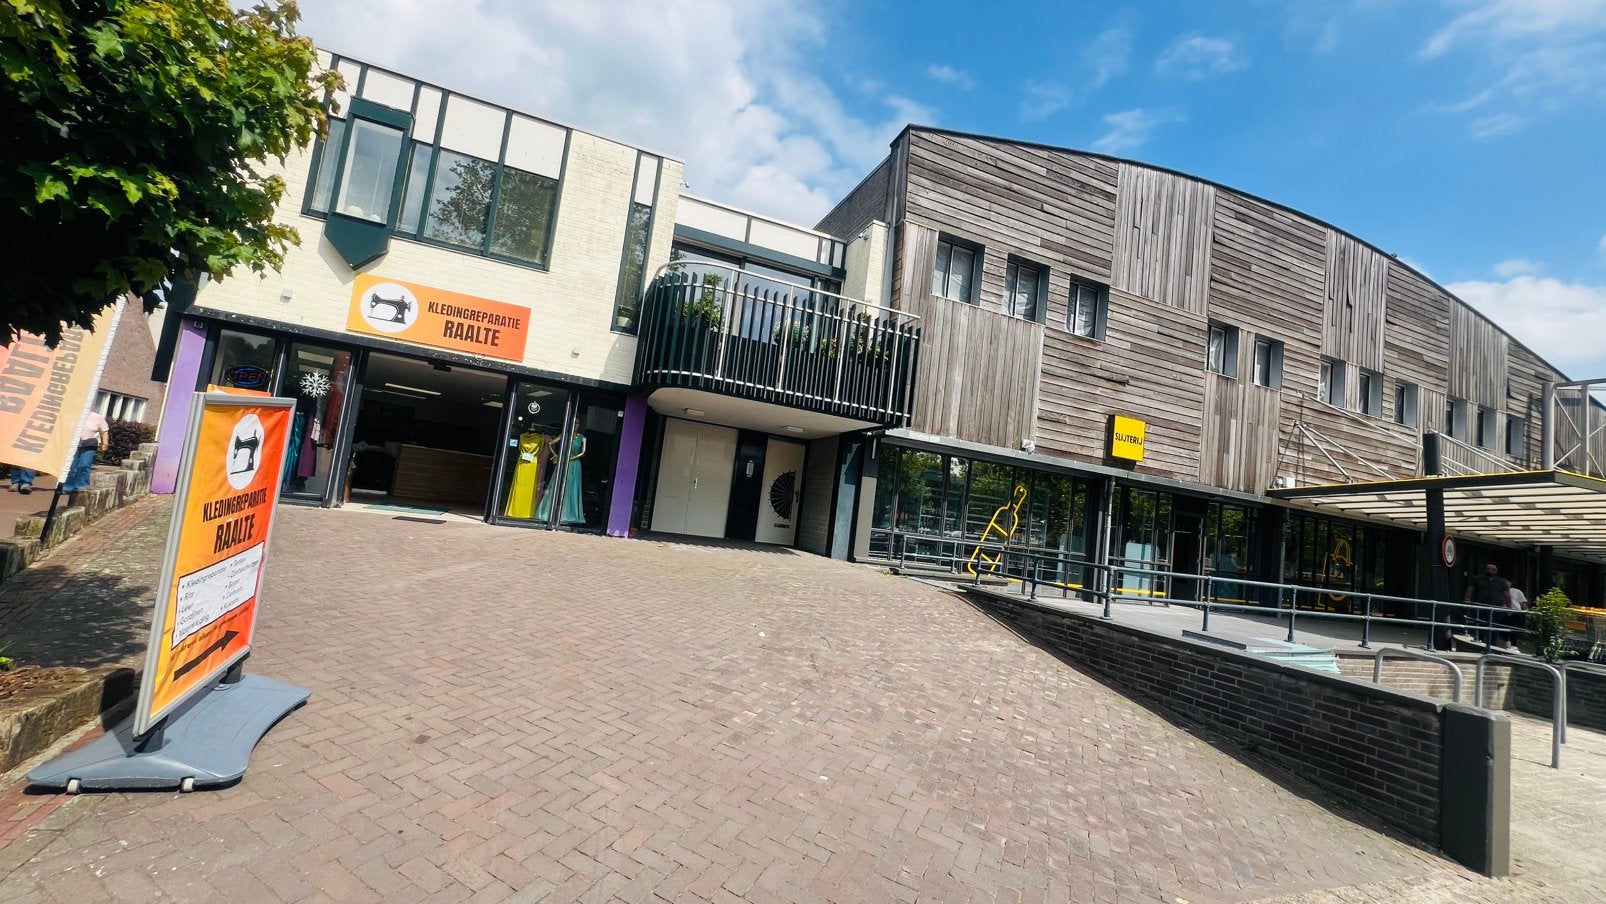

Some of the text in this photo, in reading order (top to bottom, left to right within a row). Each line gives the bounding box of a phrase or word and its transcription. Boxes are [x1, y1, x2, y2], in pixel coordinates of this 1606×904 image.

[427, 301, 521, 330] KLEDINGREPARATIE
[443, 320, 501, 347] RAALTE
[1115, 432, 1143, 445] SLIJTERIJ
[202, 487, 268, 523] KLEDINGREPARATIE
[213, 513, 256, 555] RAALTE
